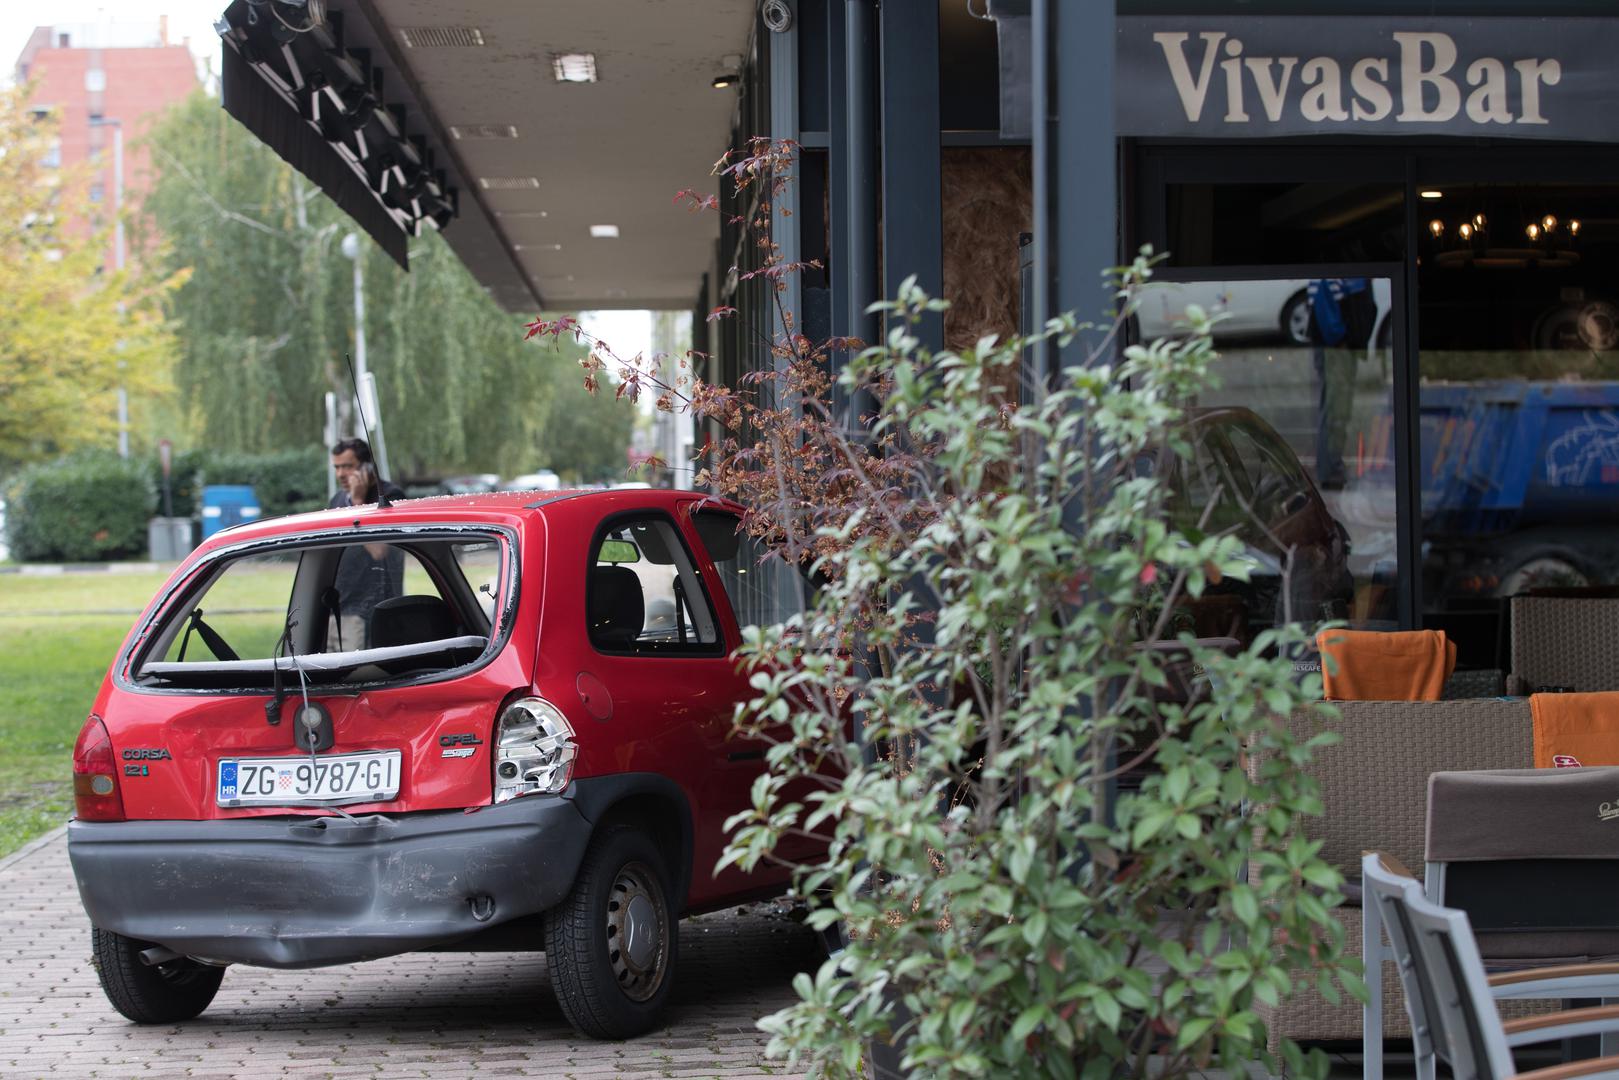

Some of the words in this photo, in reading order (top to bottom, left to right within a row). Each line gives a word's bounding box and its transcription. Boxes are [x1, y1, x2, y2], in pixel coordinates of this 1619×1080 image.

[1153, 31, 1562, 125] VivasBar
[439, 733, 483, 746] OPEL
[122, 748, 173, 760] CORSA
[241, 765, 275, 796] ZG
[222, 786, 236, 796] HR
